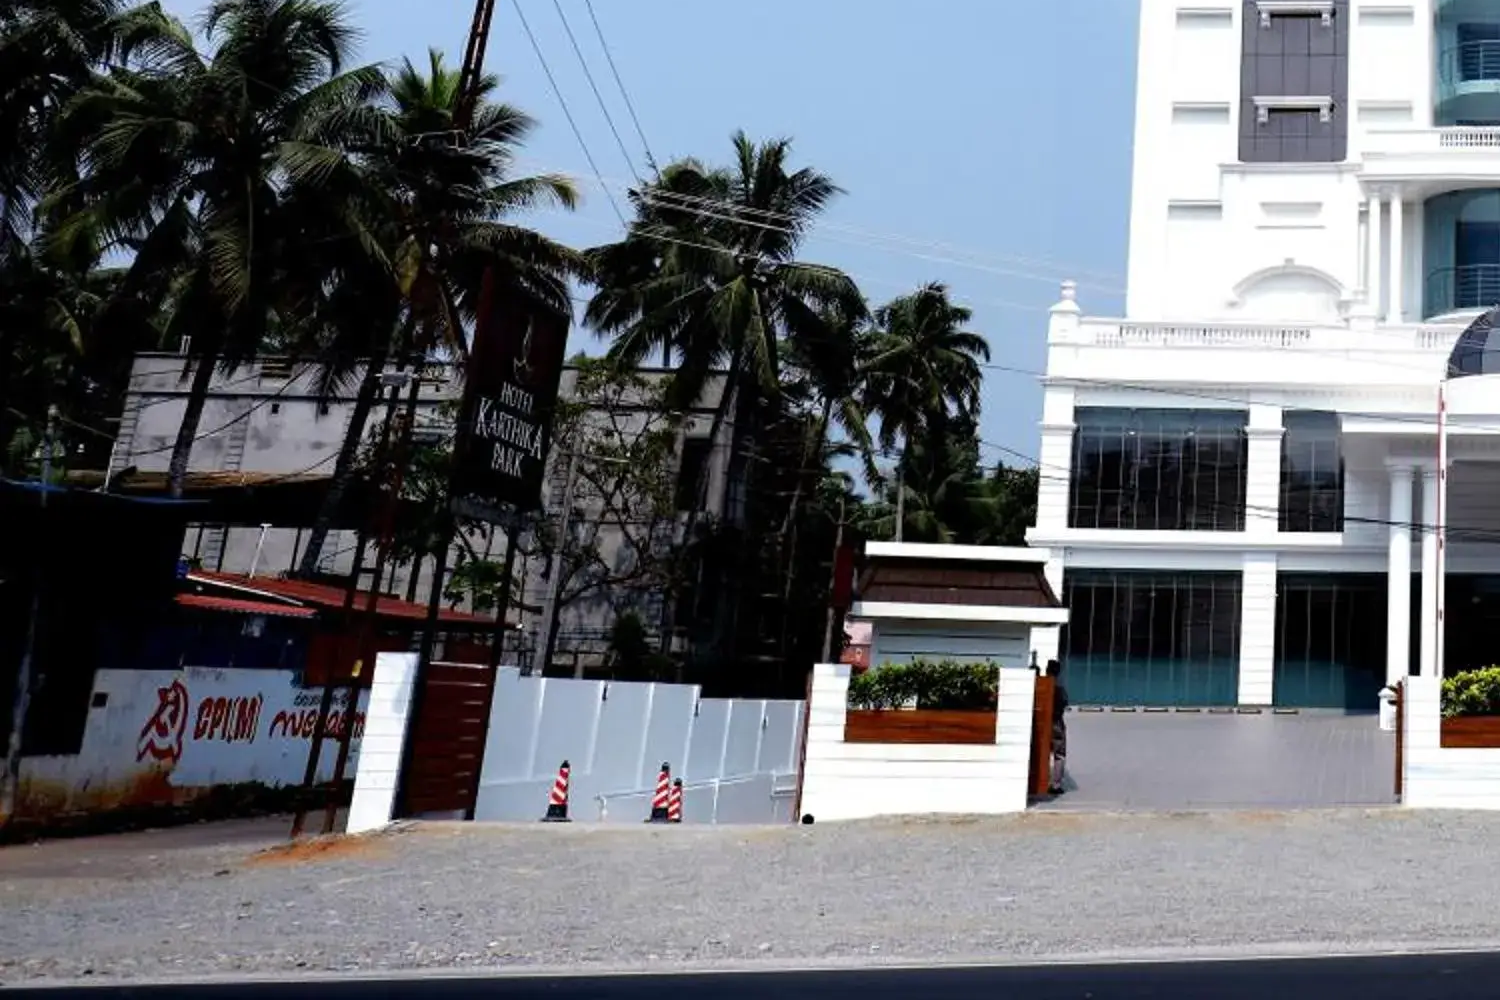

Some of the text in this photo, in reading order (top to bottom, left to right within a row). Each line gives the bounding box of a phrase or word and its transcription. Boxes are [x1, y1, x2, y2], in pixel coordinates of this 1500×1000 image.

[501, 381, 534, 415] HOTEL
[475, 397, 543, 460] KARTHIKA
[491, 442, 524, 478] PARK
[193, 692, 263, 744] CPI(M)
